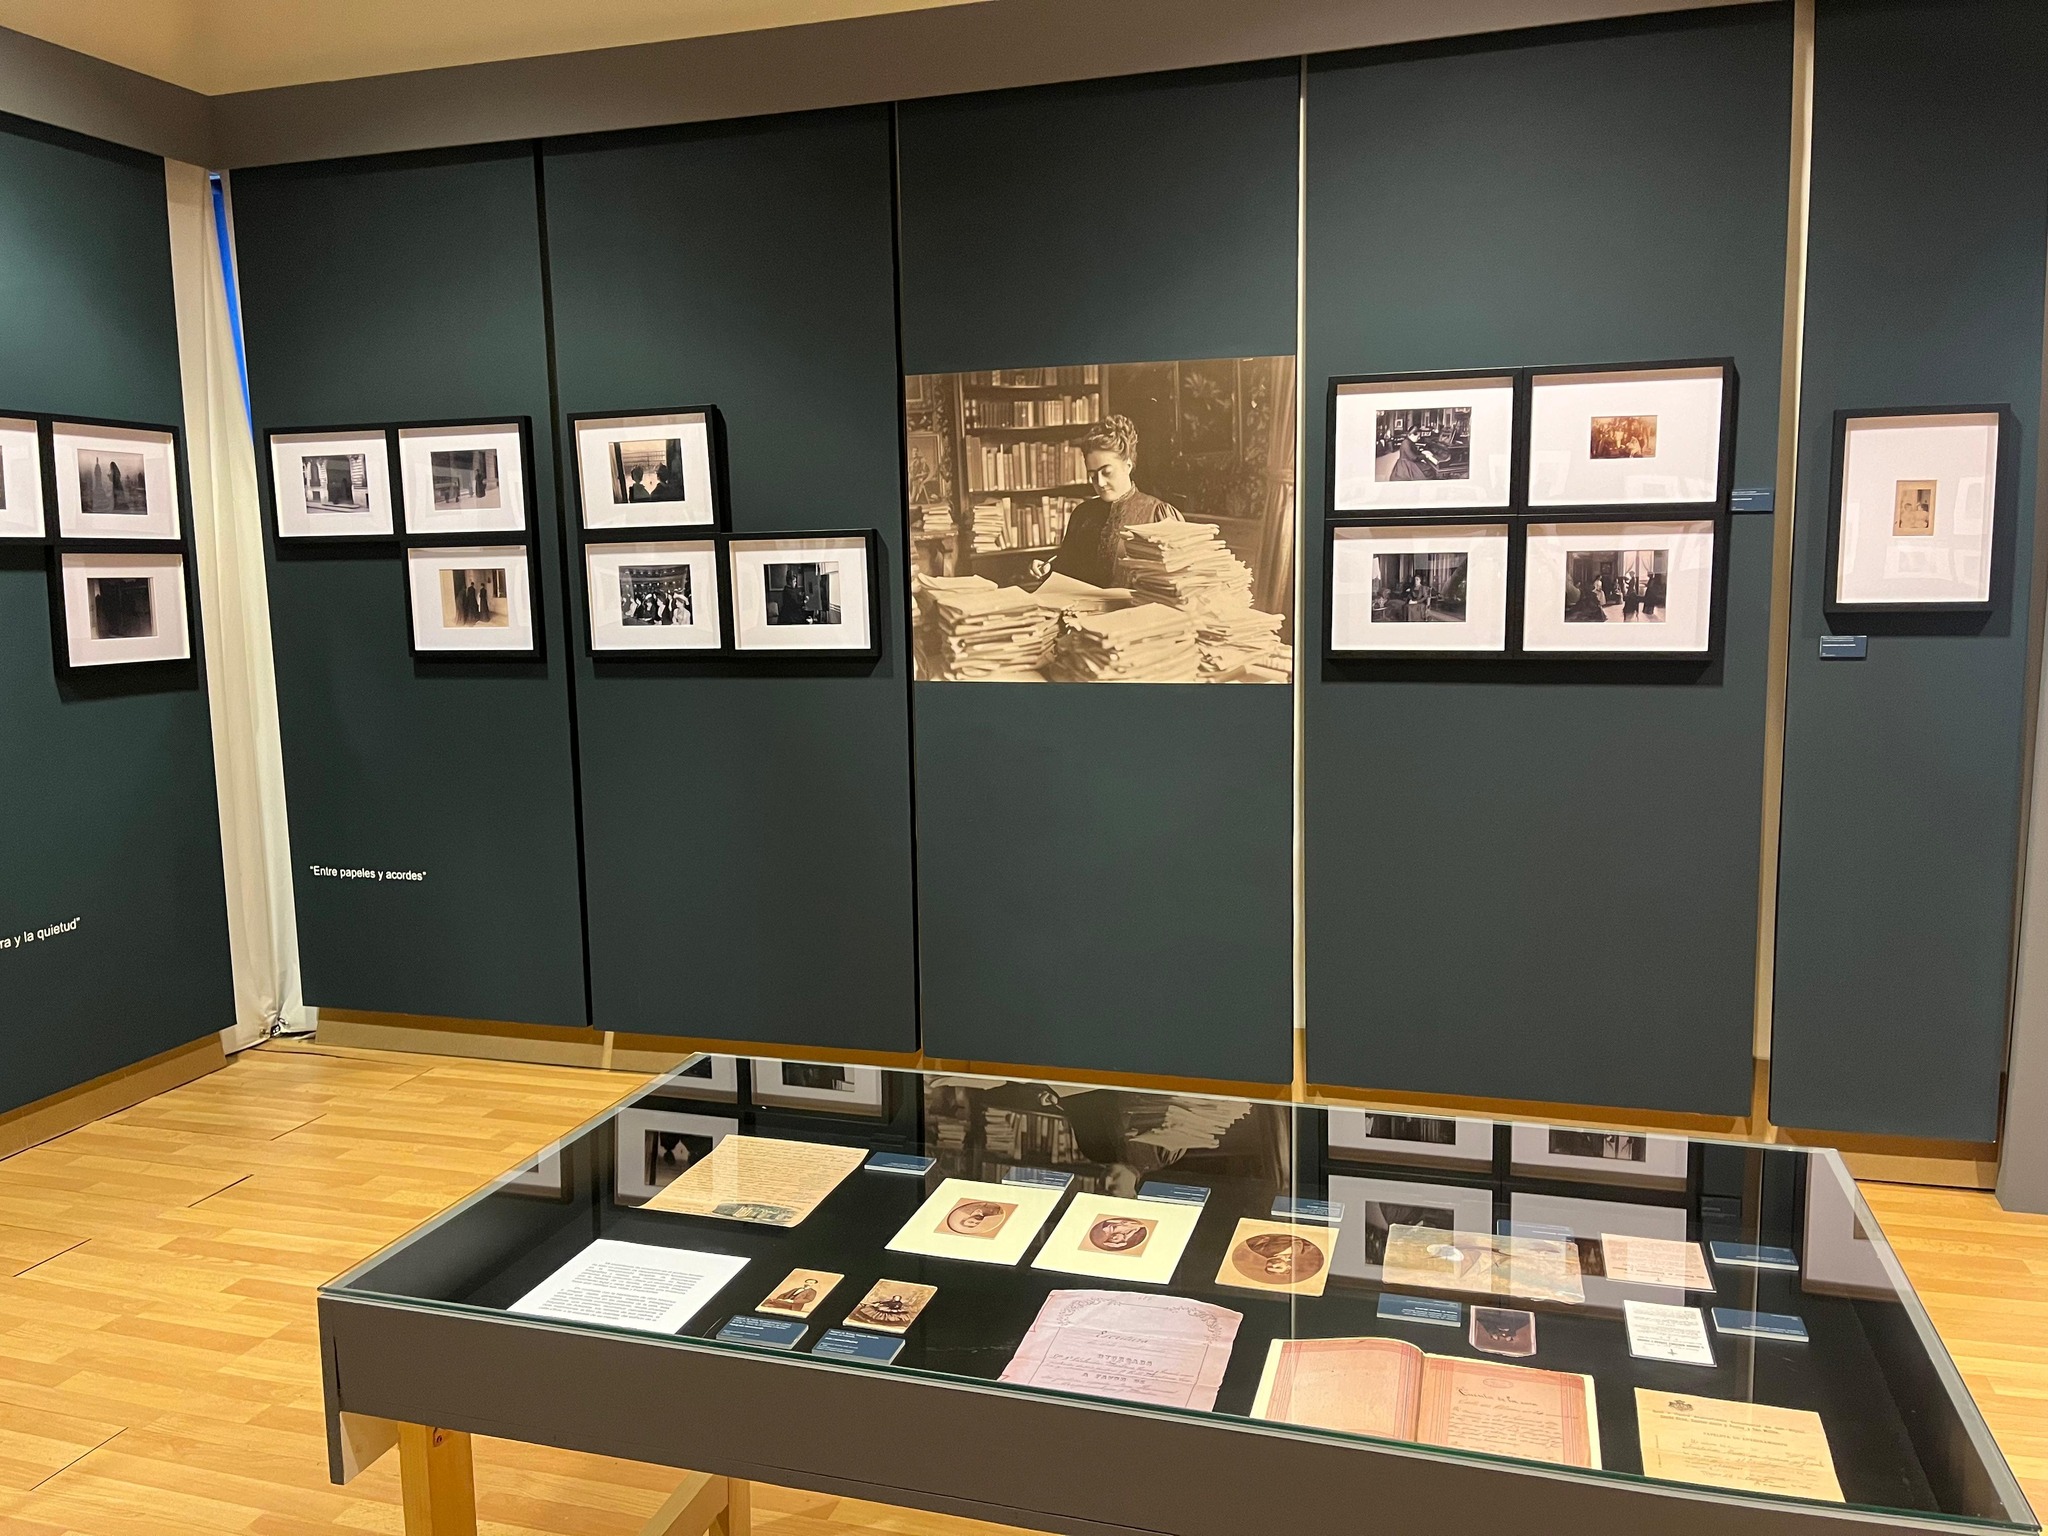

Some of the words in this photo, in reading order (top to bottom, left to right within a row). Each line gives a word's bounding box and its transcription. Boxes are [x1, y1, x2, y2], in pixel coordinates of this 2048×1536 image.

[310, 865, 338, 877] "Entre
[340, 867, 376, 879] papeles
[377, 870, 384, 881] y
[385, 870, 427, 881] acordes"
[14, 935, 21, 948] y
[23, 931, 35, 943] la
[37, 916, 81, 941] quietud"
